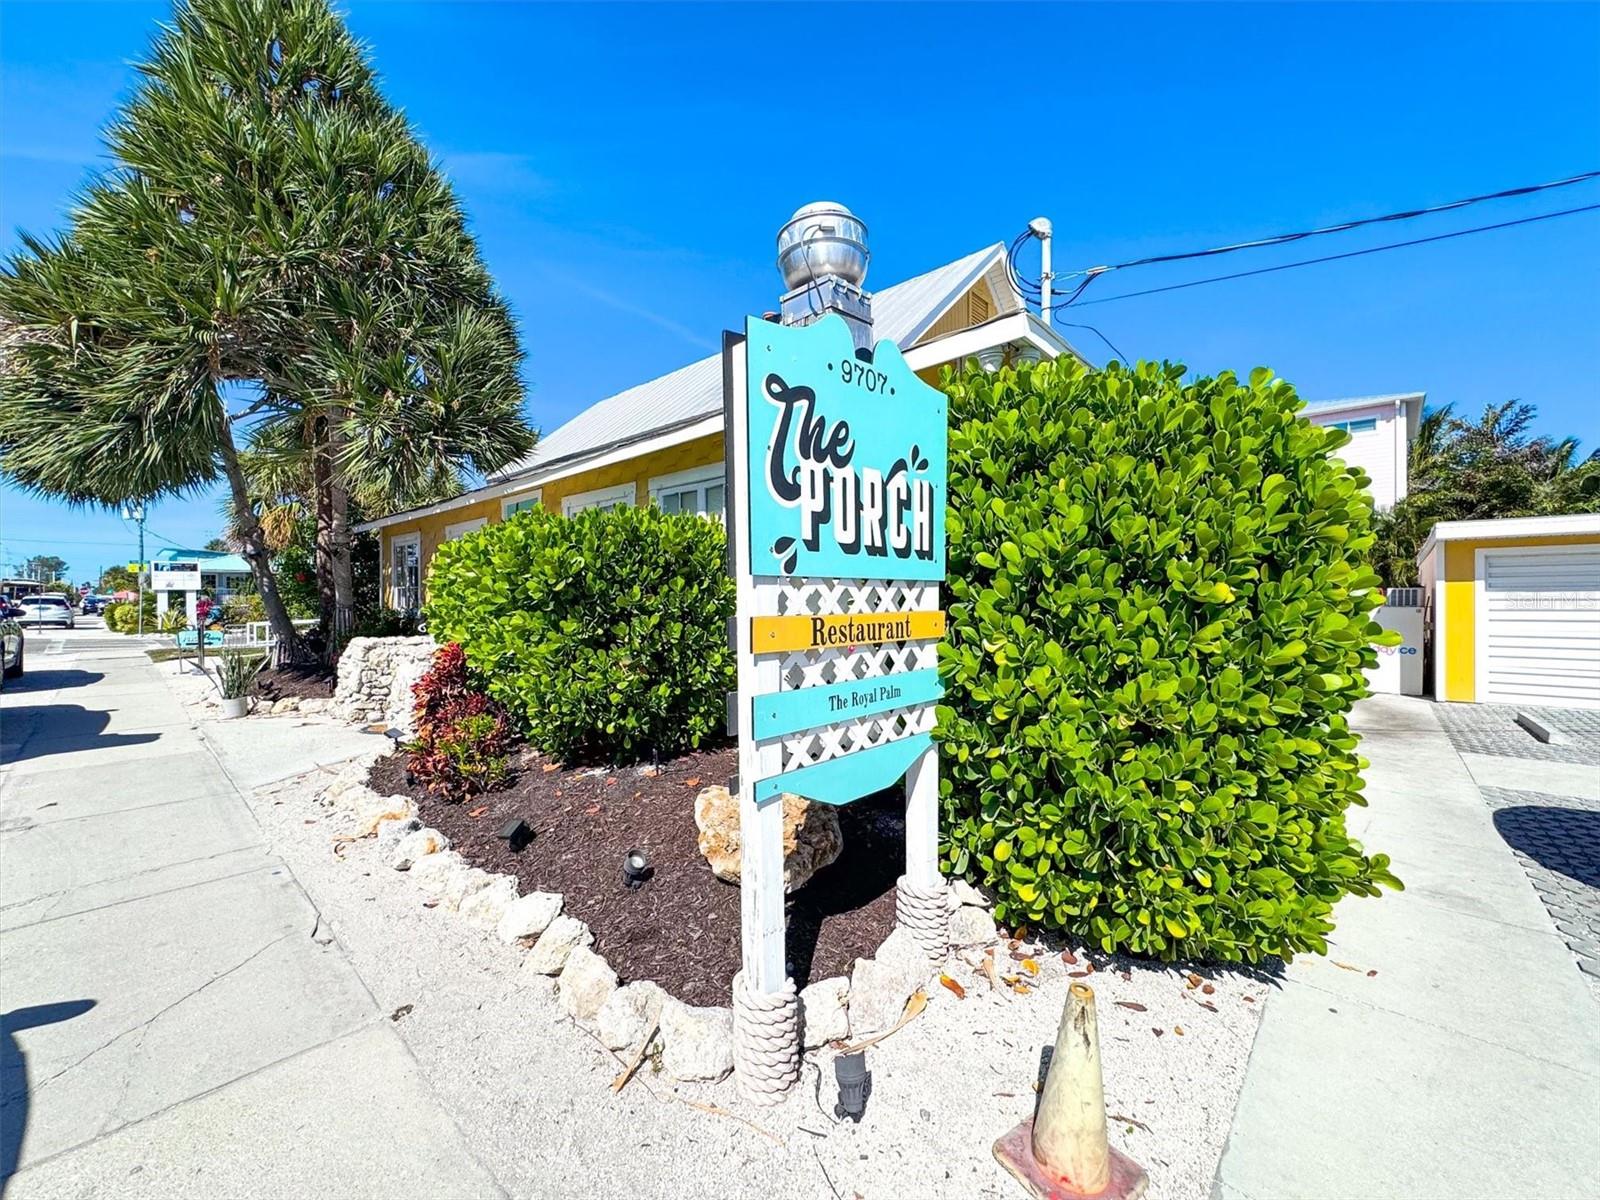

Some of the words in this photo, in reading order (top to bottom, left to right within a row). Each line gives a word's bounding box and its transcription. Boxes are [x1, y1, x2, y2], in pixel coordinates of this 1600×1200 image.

[841, 359, 888, 395] 9707
[763, 372, 856, 503] The
[800, 461, 935, 561] PORCH
[810, 614, 912, 646] Restaurant
[828, 694, 848, 712] The
[851, 687, 877, 708] Royal
[879, 684, 902, 701] Palm
